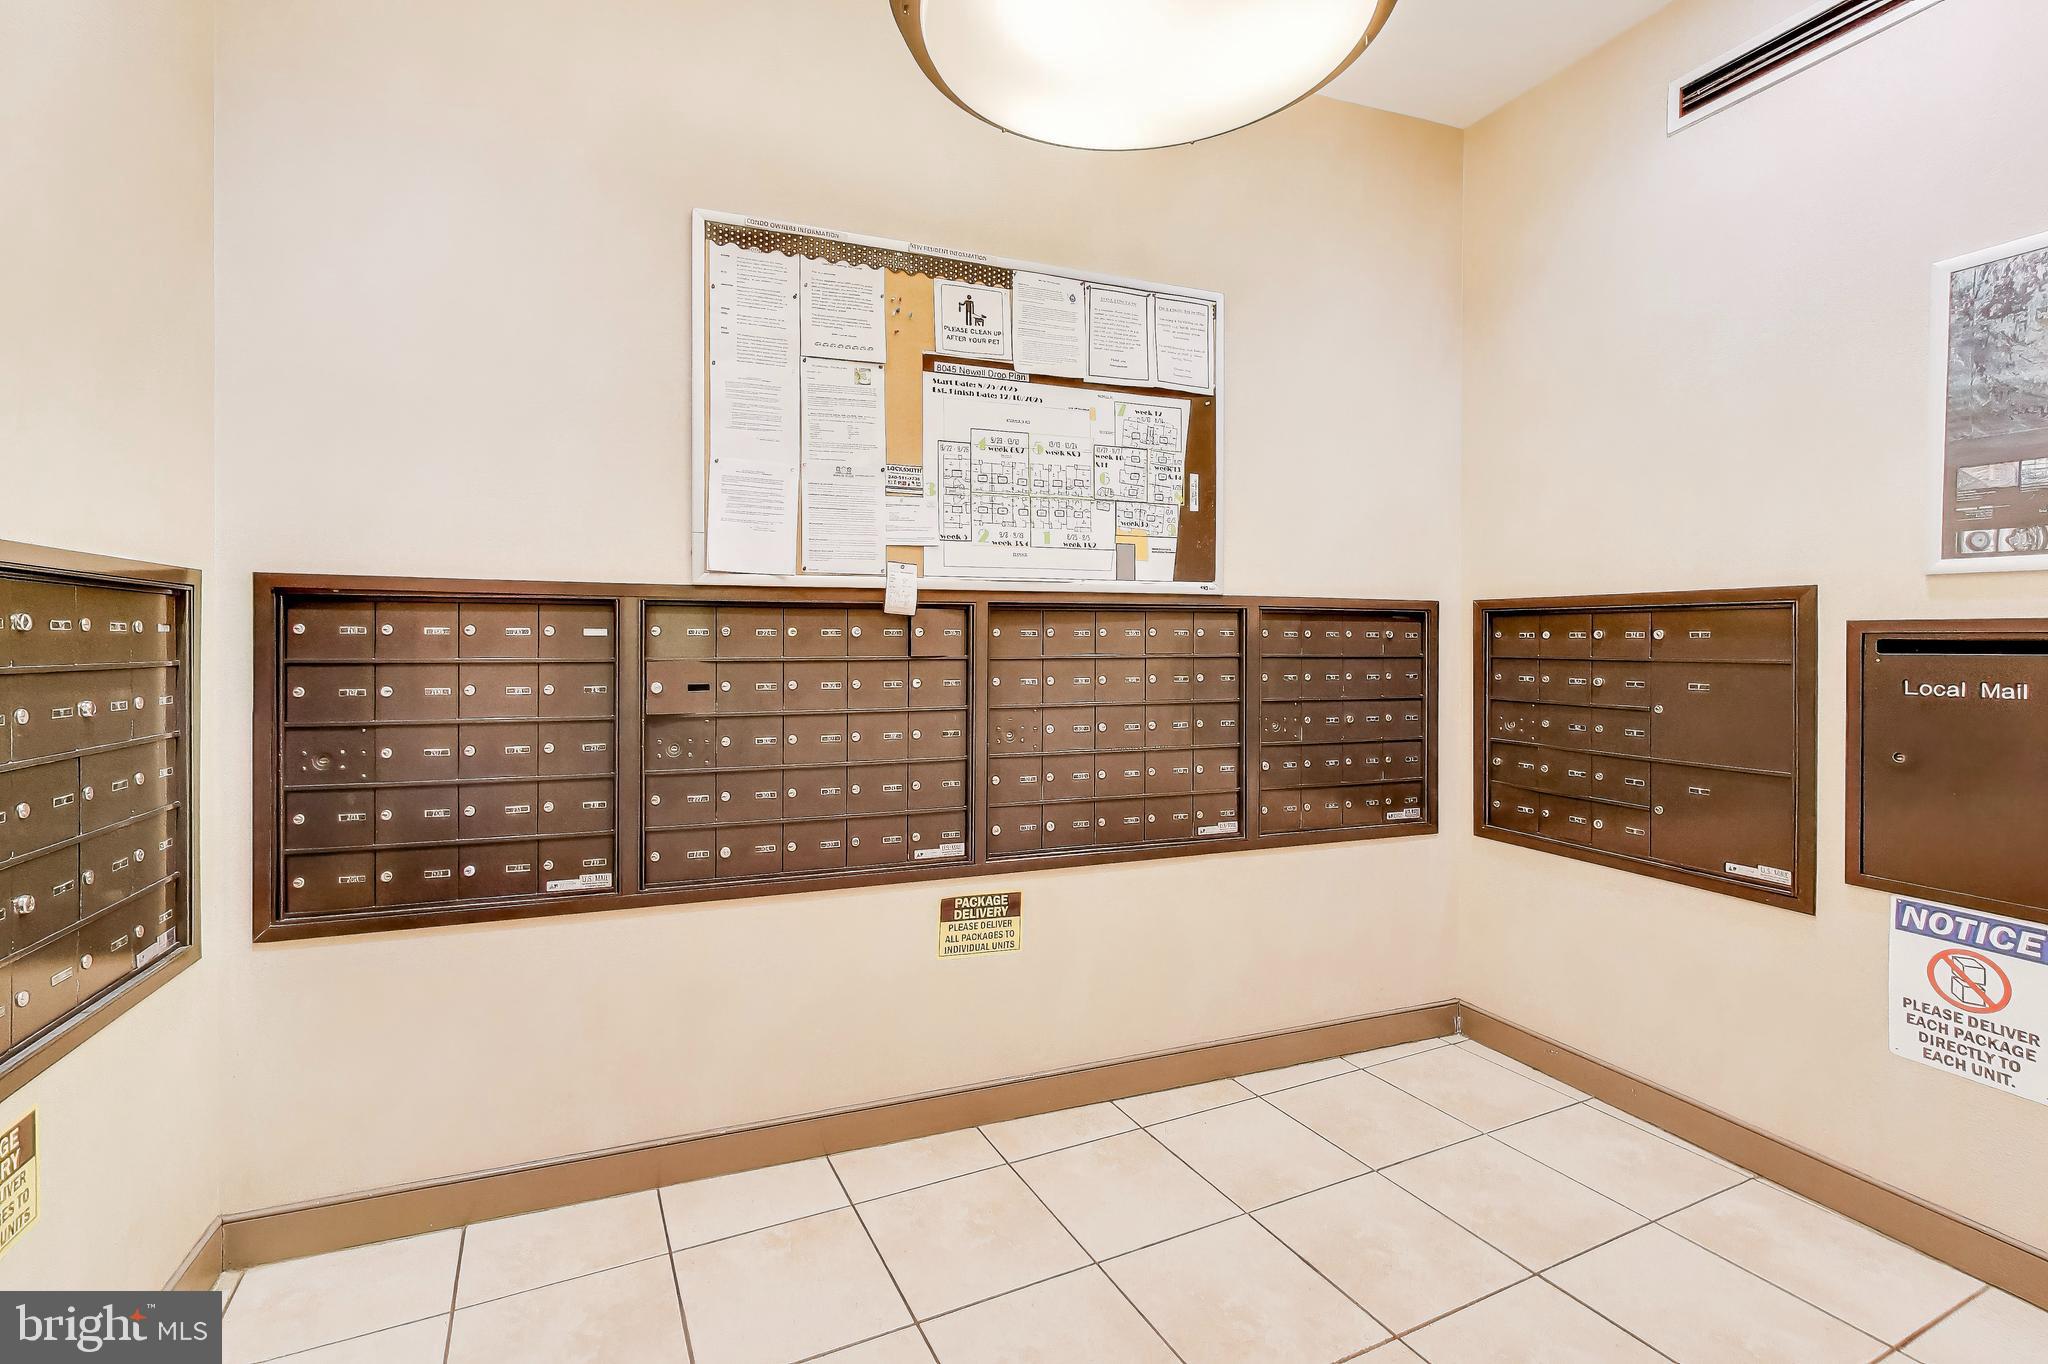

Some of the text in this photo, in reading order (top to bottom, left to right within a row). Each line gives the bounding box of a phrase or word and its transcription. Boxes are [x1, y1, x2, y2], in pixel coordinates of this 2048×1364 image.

[747, 218, 840, 239] CONDO OWNERS INFORMATION
[923, 246, 949, 255] RESIDENT
[949, 250, 987, 261] INFORMATION
[944, 325, 968, 333] PLEASE
[936, 364, 957, 373] 8045
[959, 366, 986, 377] Newell
[1008, 372, 1026, 381] Plan
[932, 378, 953, 386] Start
[949, 388, 975, 397] Finish
[976, 391, 998, 399] Date:
[1903, 679, 2029, 700] Local Mail
[955, 894, 1009, 909] PACKAGE
[953, 906, 1009, 920] DELIVERY
[948, 919, 1012, 932] PLEASE DELIVER
[1901, 905, 2047, 958] NOTICE
[944, 930, 1015, 943] ALL PACKAGES TO
[944, 940, 1015, 954] INDIVIDUAL UNITS
[1902, 996, 2040, 1047] PLEASE DELIVER
[1906, 1012, 2037, 1063] EACH PACKAGE
[1918, 1031, 2021, 1073] DIRECTLY TO
[1922, 1047, 2016, 1088] EACH UNIT.
[17, 1187, 30, 1209] TO
[0, 1206, 30, 1247] UNITS
